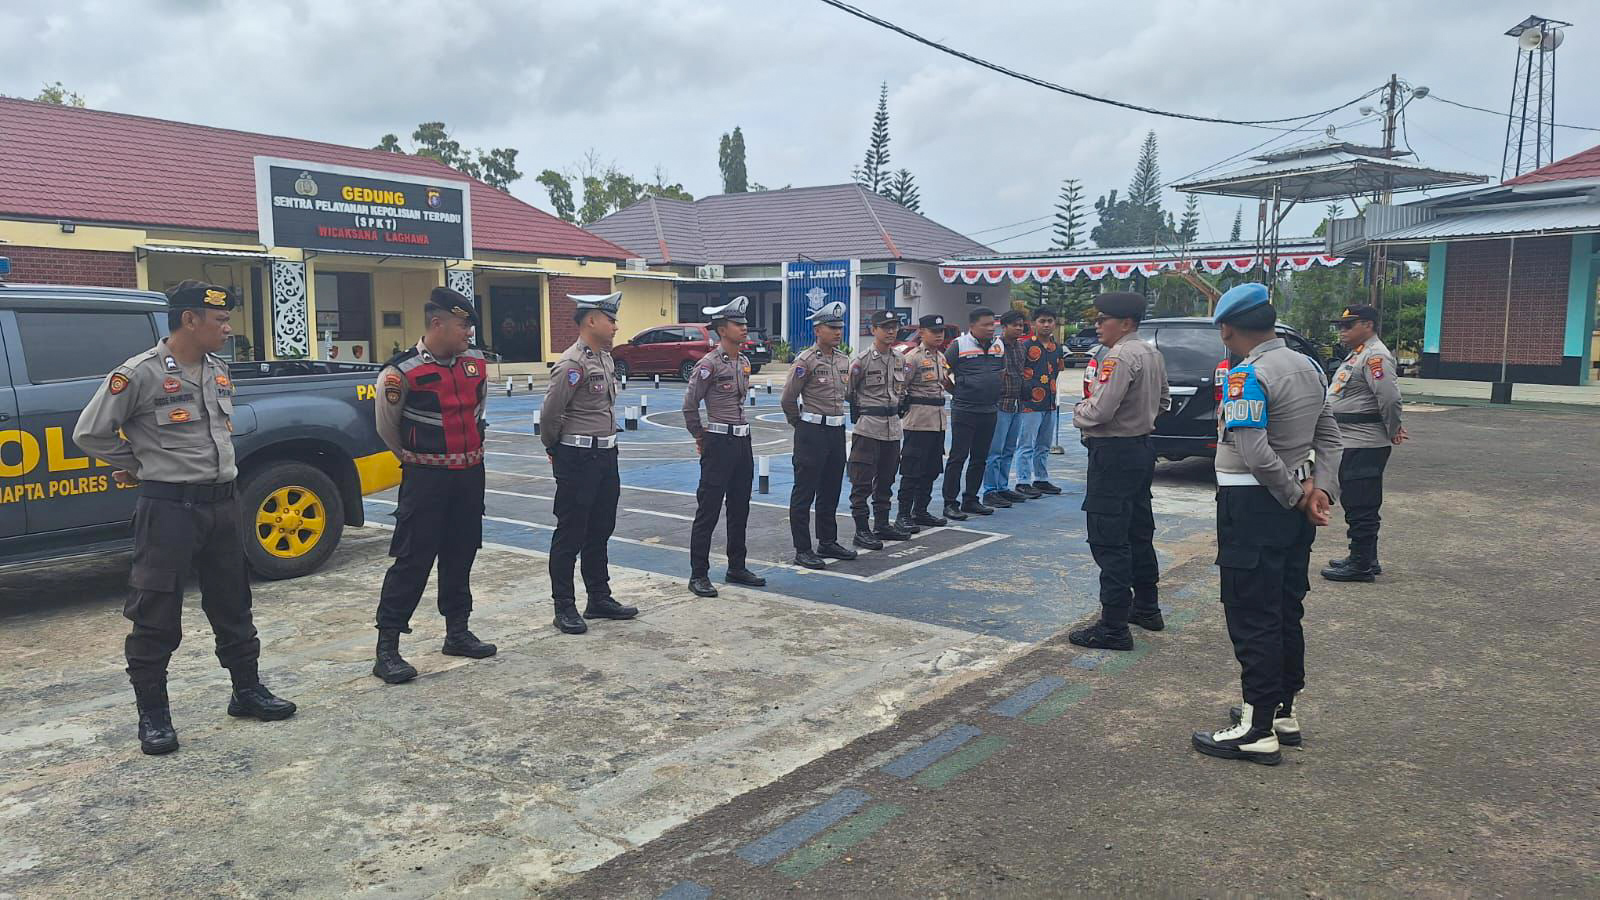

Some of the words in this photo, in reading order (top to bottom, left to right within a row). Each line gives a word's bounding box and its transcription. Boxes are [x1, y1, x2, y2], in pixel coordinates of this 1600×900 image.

[341, 186, 405, 205] GEDUNG
[273, 196, 313, 210] SENTRA
[315, 199, 369, 215] PELAYANAN
[370, 205, 421, 220] KEPOLISIAN
[423, 210, 461, 224] TERPADU
[319, 226, 379, 241] WICAKSANA
[384, 231, 430, 245] LAGHAWA
[356, 383, 376, 401] PA
[0, 482, 45, 503] APTA
[49, 475, 108, 498] POLRES
